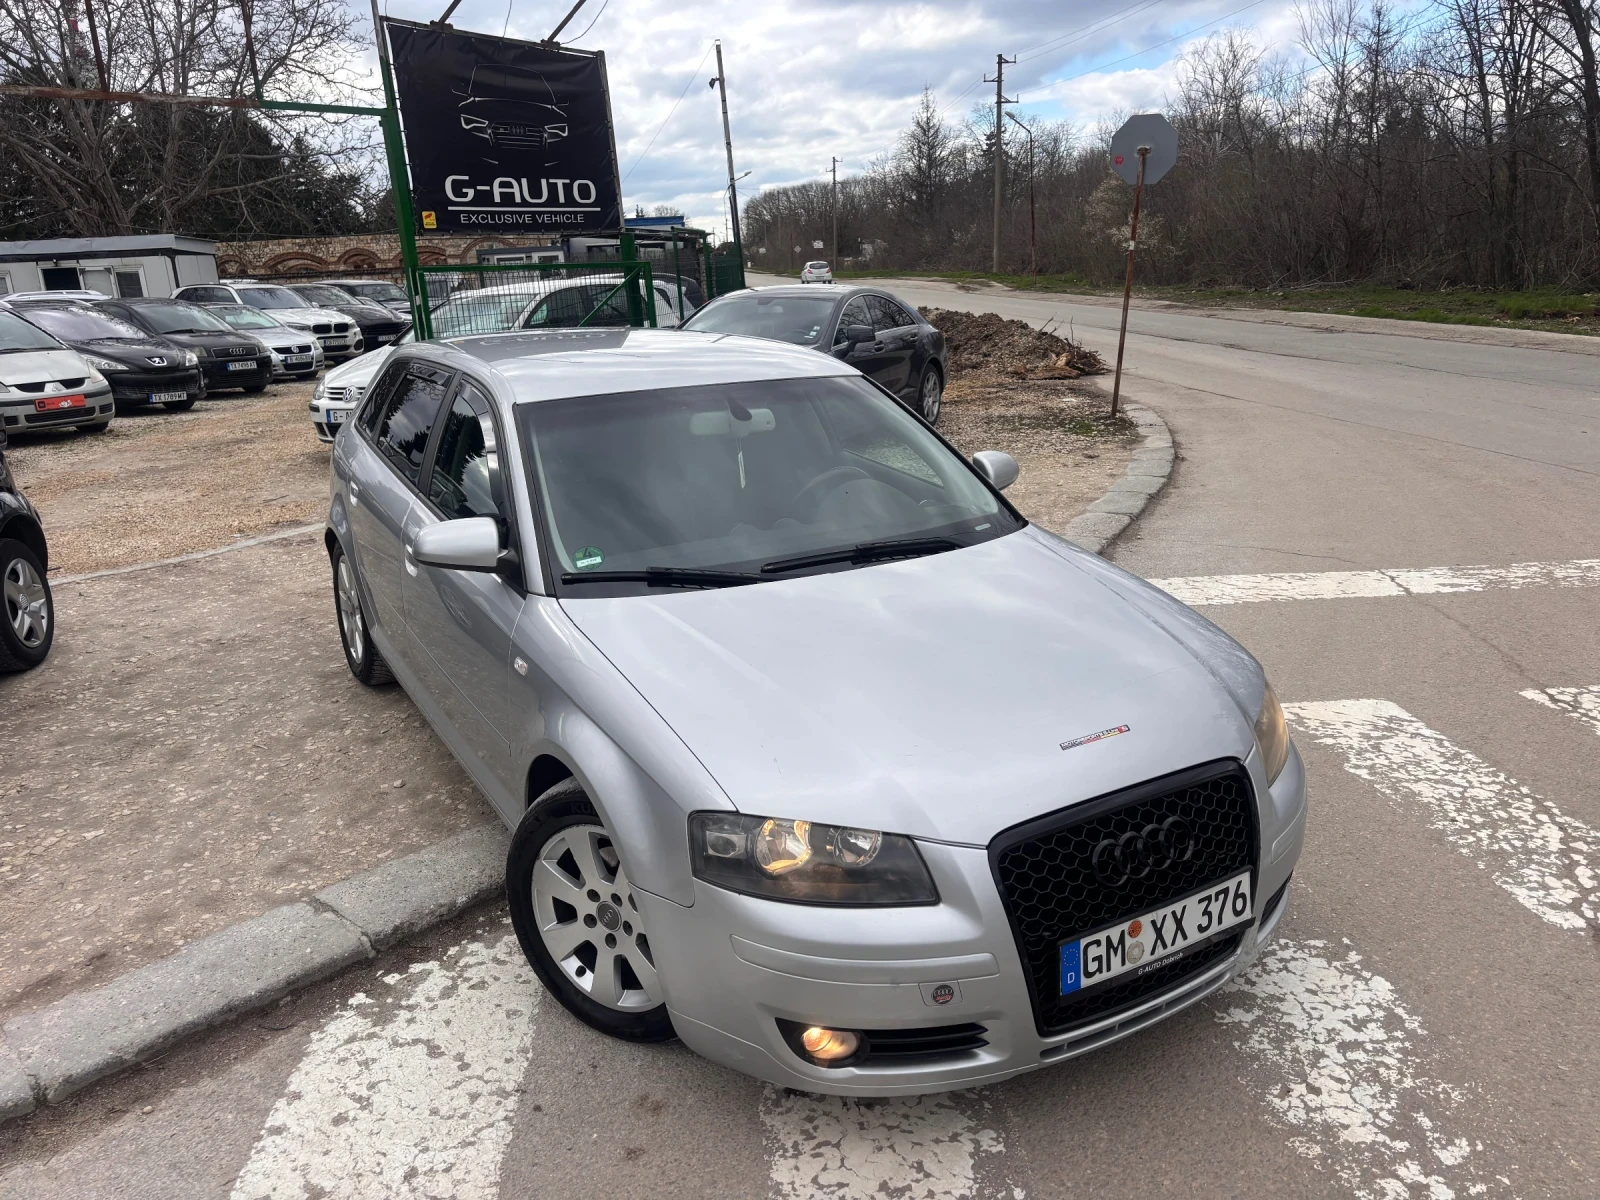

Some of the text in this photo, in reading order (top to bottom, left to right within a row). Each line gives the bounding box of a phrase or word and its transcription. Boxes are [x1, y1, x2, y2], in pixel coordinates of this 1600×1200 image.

[445, 175, 597, 204] G-AUTO
[460, 213, 585, 224] EXCLUSIVE VEHICLE
[1082, 880, 1247, 979] GM XX 376
[1138, 961, 1162, 975] G-AUTO
[1067, 972, 1075, 984] D
